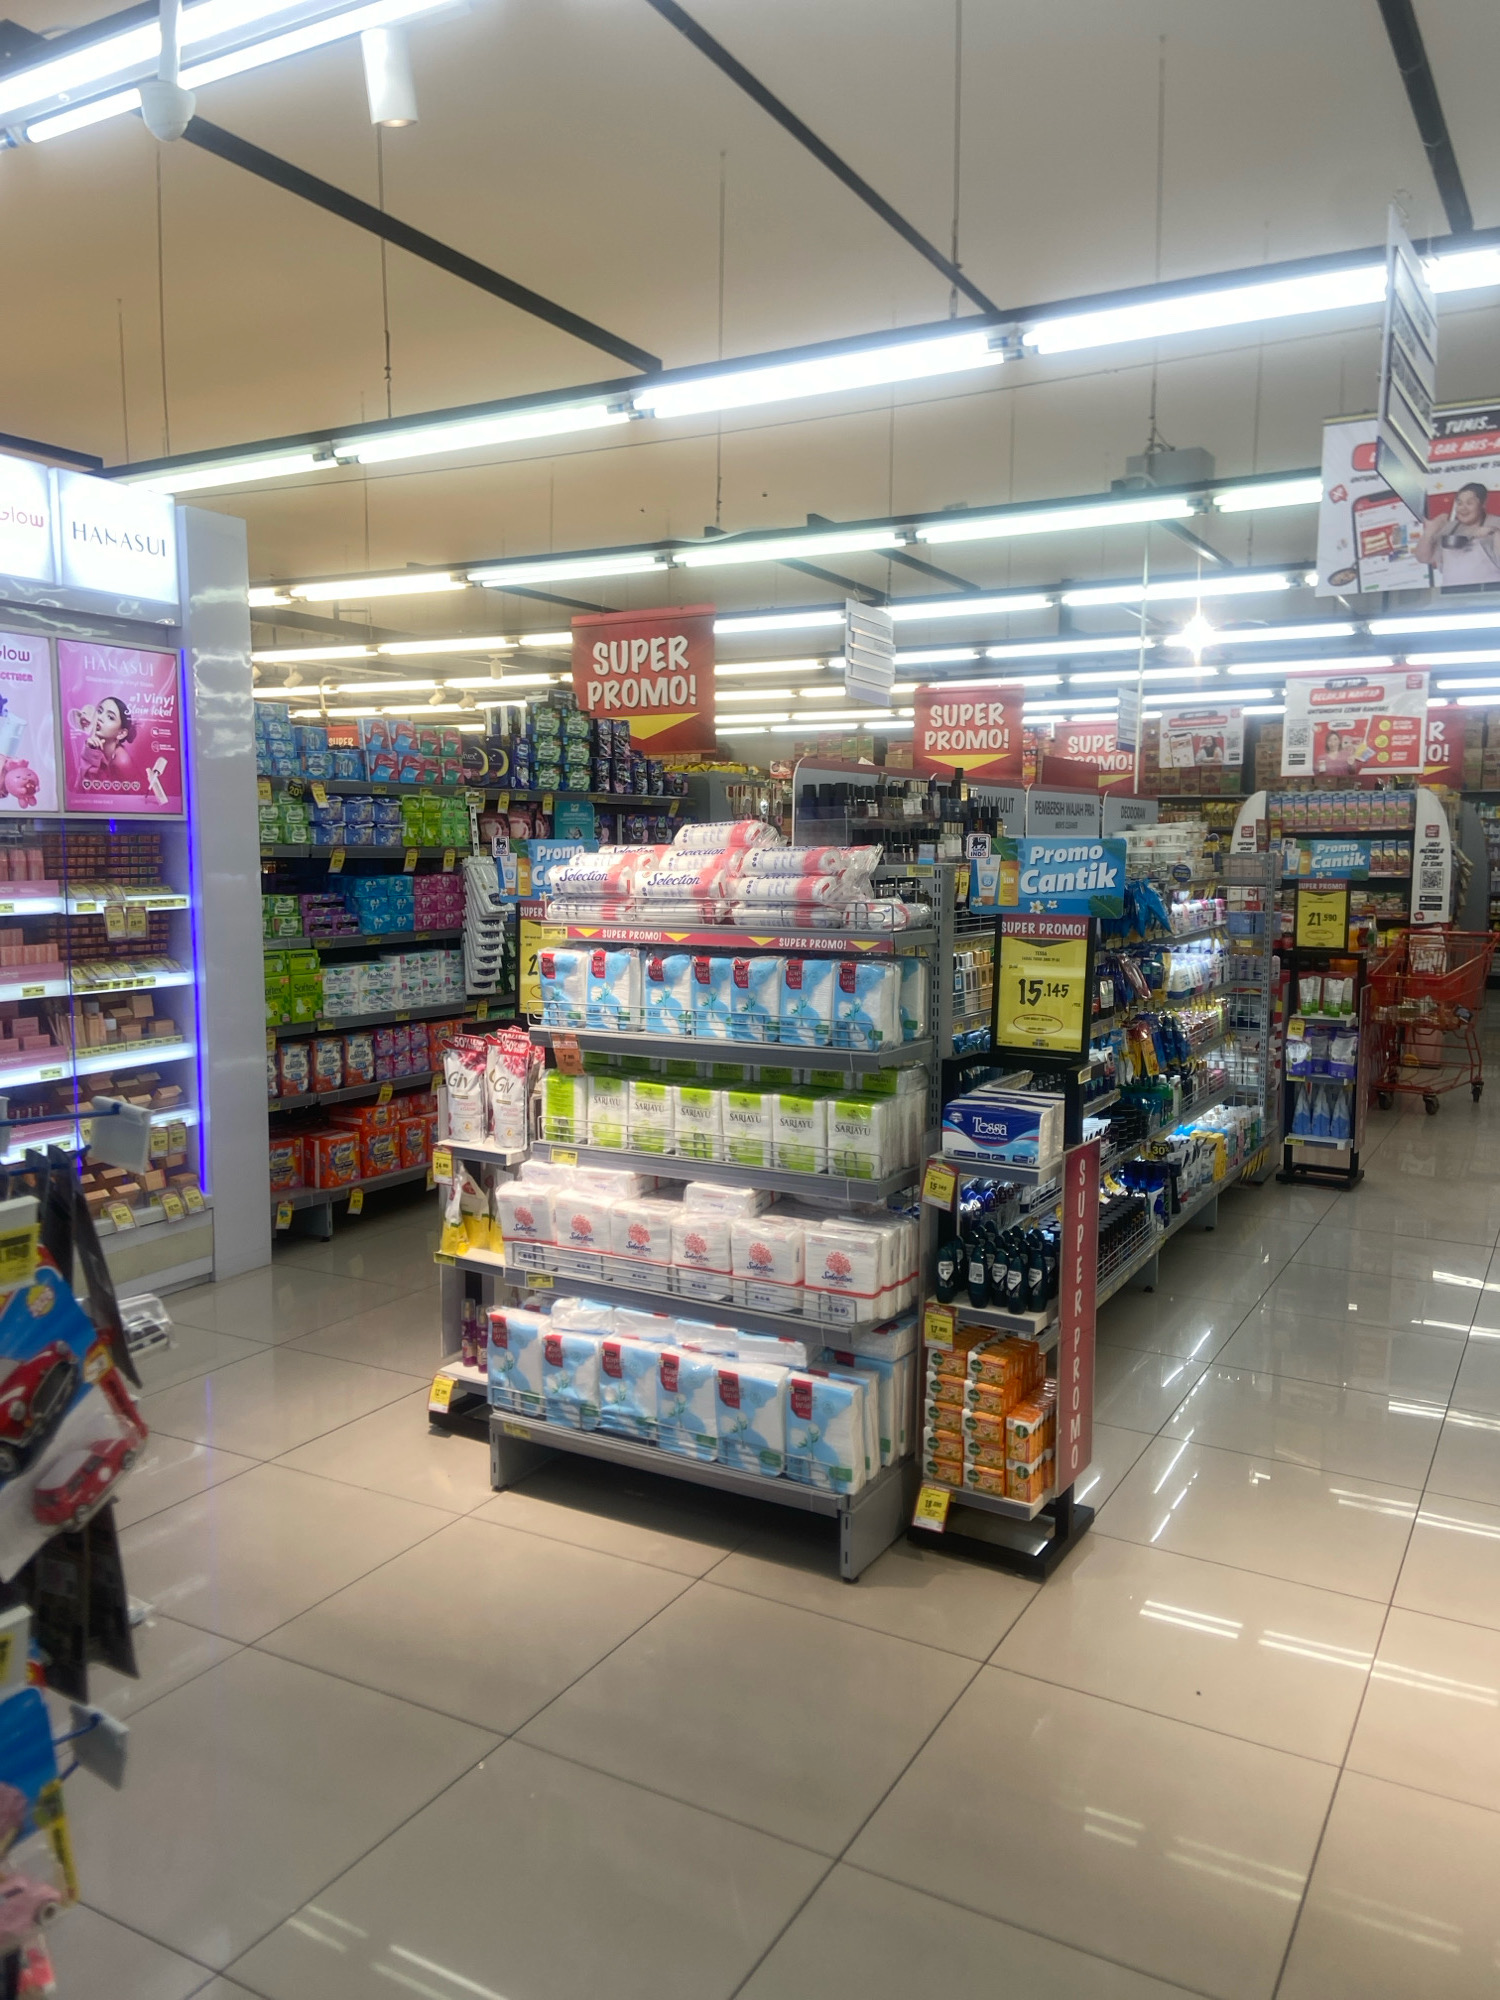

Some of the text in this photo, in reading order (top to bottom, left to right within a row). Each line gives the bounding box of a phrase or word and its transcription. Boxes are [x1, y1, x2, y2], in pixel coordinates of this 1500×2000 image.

[71, 520, 167, 557] HANASUI
[592, 634, 691, 676] SUPER
[83, 655, 154, 677] HANASUI
[587, 674, 697, 711] PROMO!
[143, 694, 174, 709] Vinyl
[929, 702, 1005, 728] SUPER
[327, 737, 354, 747] SUPER
[923, 727, 1010, 751] PROMO!
[1067, 733, 1121, 755] SUPE
[1034, 800, 1064, 815] PEMBERSIH
[1085, 803, 1095, 817] PRIA
[1029, 845, 1104, 866] Promo
[1316, 843, 1358, 854] Promo
[1311, 852, 1366, 869] Cantik
[559, 867, 609, 883] Selection
[647, 871, 701, 887] Selection
[1020, 862, 1118, 895] Cantik
[519, 905, 544, 918] SUPER
[1307, 911, 1338, 927] 21.590
[602, 928, 662, 941] SUPER PROMO!
[1001, 921, 1087, 937] SUPER PROMO!
[779, 937, 847, 950] SUPER PROMO!
[265, 984, 283, 995] oftex
[294, 982, 318, 992] Softex
[1018, 978, 1070, 1006] 15.145
[454, 1034, 470, 1049] 50%
[448, 1070, 473, 1089] Giv
[493, 1075, 515, 1095] Giv
[634, 1100, 665, 1114] SARIAYU
[680, 1106, 711, 1120] SARIAYU
[728, 1111, 762, 1125] SARIAYU
[779, 1117, 814, 1131] SARIAYU
[834, 1123, 871, 1137] SARIAYU
[972, 1116, 1008, 1136] Tessa
[513, 1223, 538, 1233] Selection
[569, 1231, 594, 1243] Selection
[626, 1240, 652, 1252] Selection
[684, 1250, 710, 1263] Selection
[746, 1261, 775, 1274] Selection
[822, 1270, 853, 1284] Selection
[1069, 1157, 1087, 1470] SUPER PROMO
